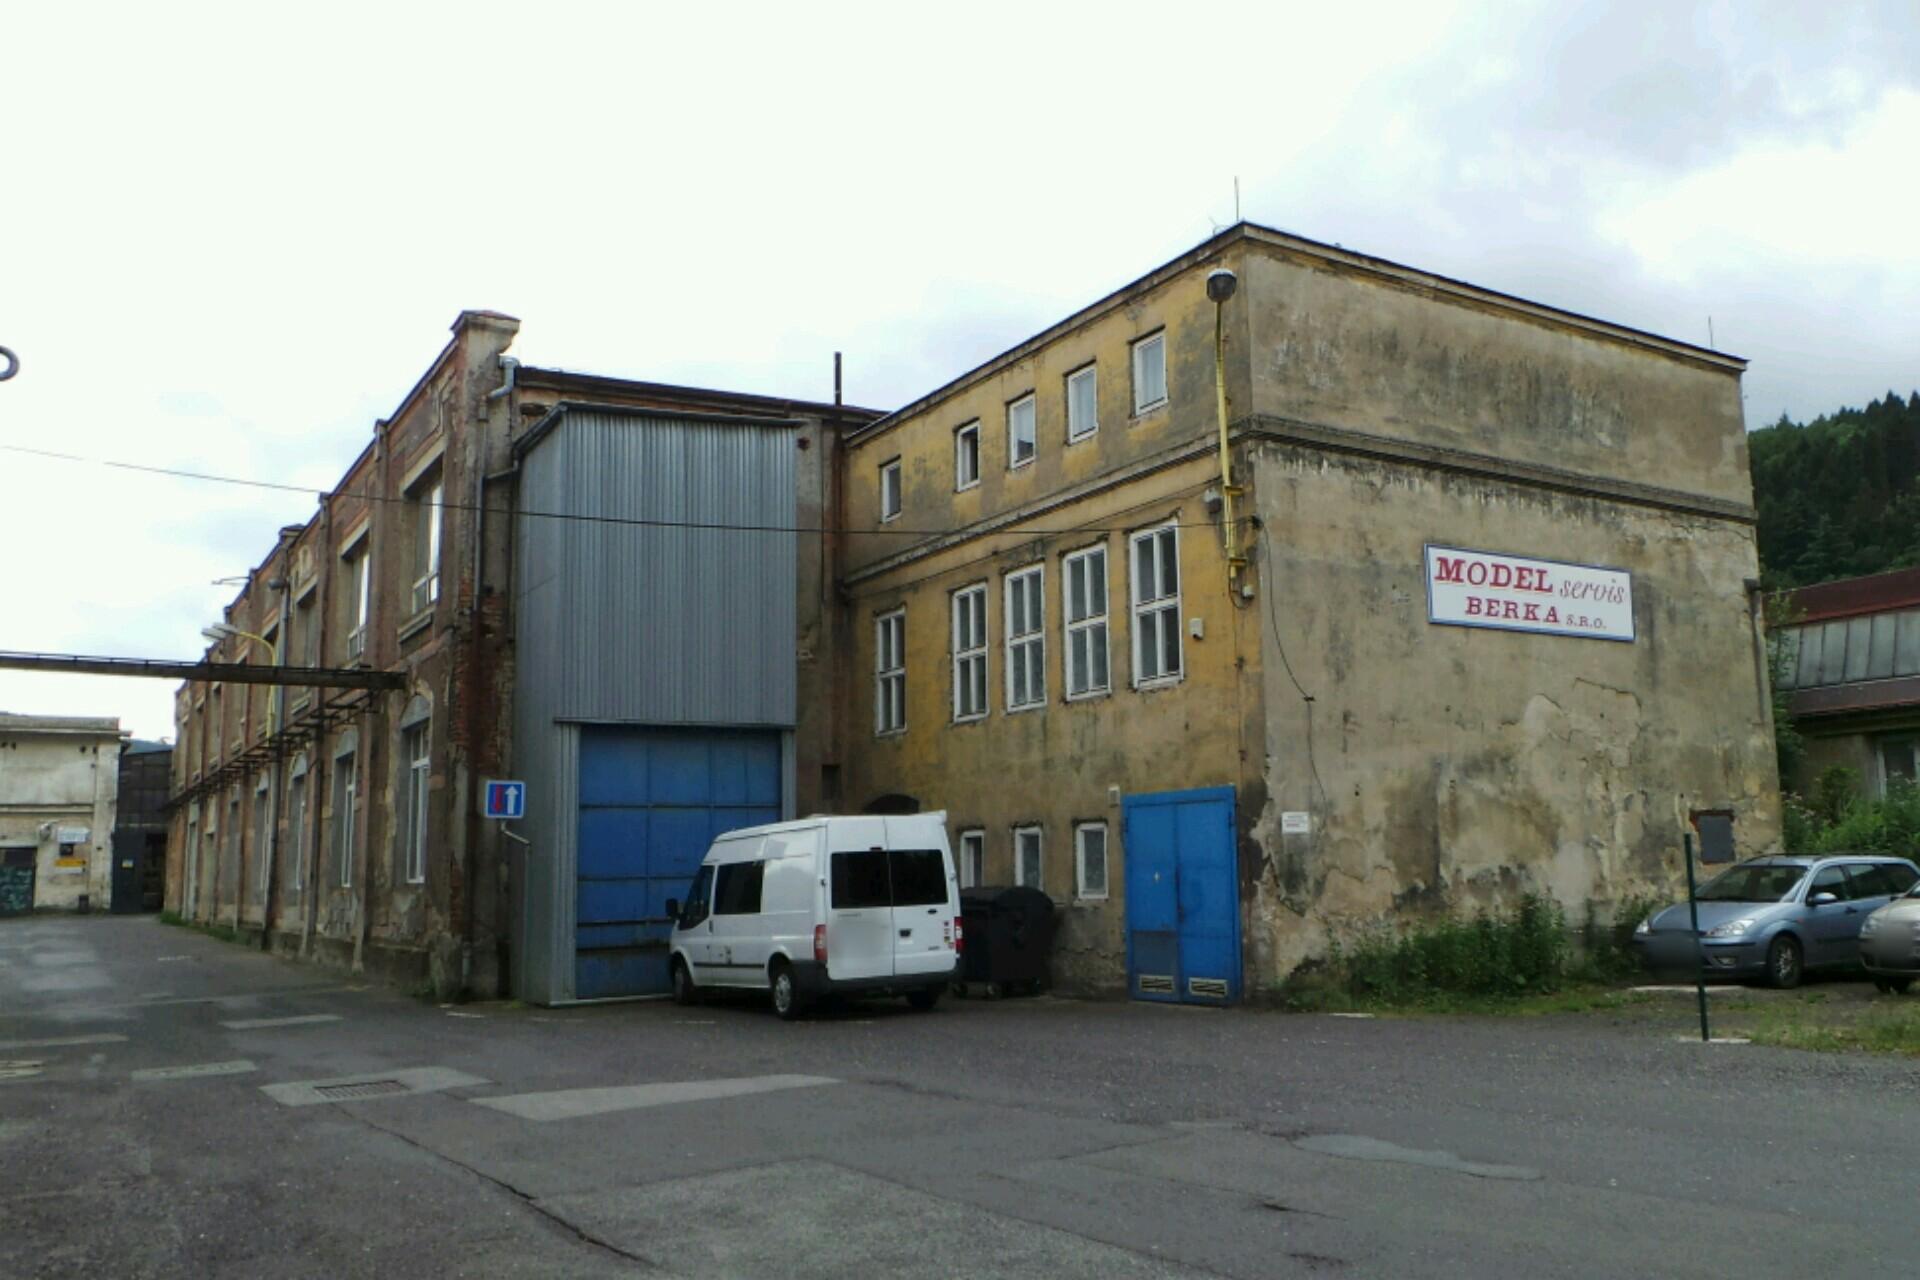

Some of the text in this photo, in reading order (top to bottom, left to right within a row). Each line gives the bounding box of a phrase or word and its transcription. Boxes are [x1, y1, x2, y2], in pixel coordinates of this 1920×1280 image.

[1434, 556, 1624, 604] MODEL servis
[1465, 596, 1607, 629] BERKA S.R.O.
